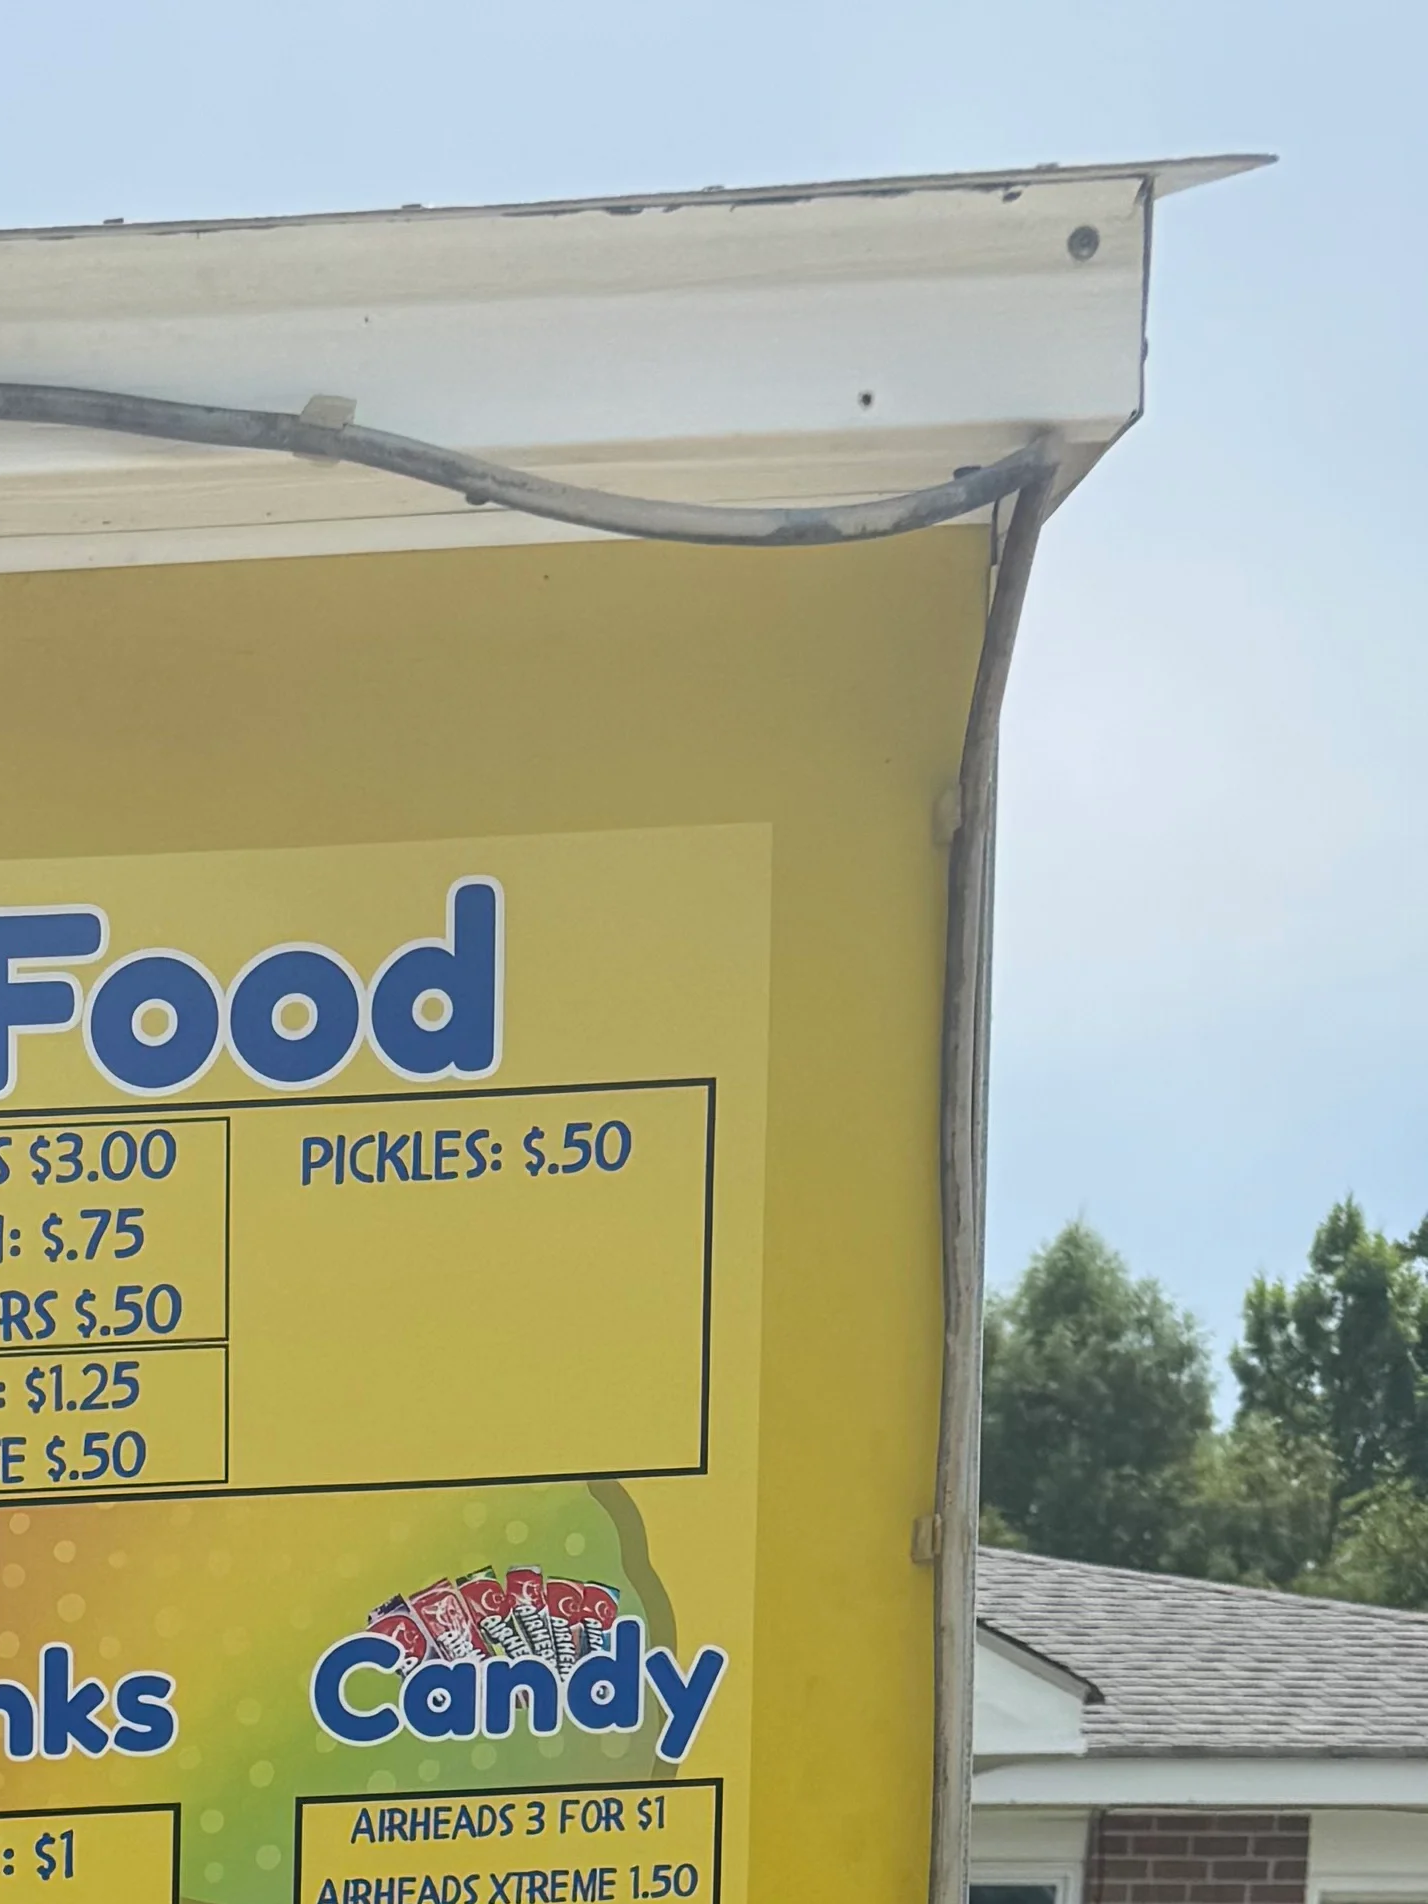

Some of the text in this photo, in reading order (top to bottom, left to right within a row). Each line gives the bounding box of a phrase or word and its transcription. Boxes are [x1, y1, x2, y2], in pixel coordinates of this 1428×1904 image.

[30, 1123, 176, 1185] $3.00
[303, 1121, 631, 1185] PICKLES: $.50
[42, 1208, 143, 1261] $.75
[76, 1284, 181, 1338] $.50
[26, 1362, 139, 1412] $1.25
[46, 1432, 145, 1482] $.50
[316, 1617, 723, 1758] Candy
[353, 1798, 663, 1840] AIRHEADS 3 FOR $1
[35, 1832, 72, 1880] $1
[490, 1869, 613, 1904] XTREME
[632, 1865, 697, 1897] 1.50
